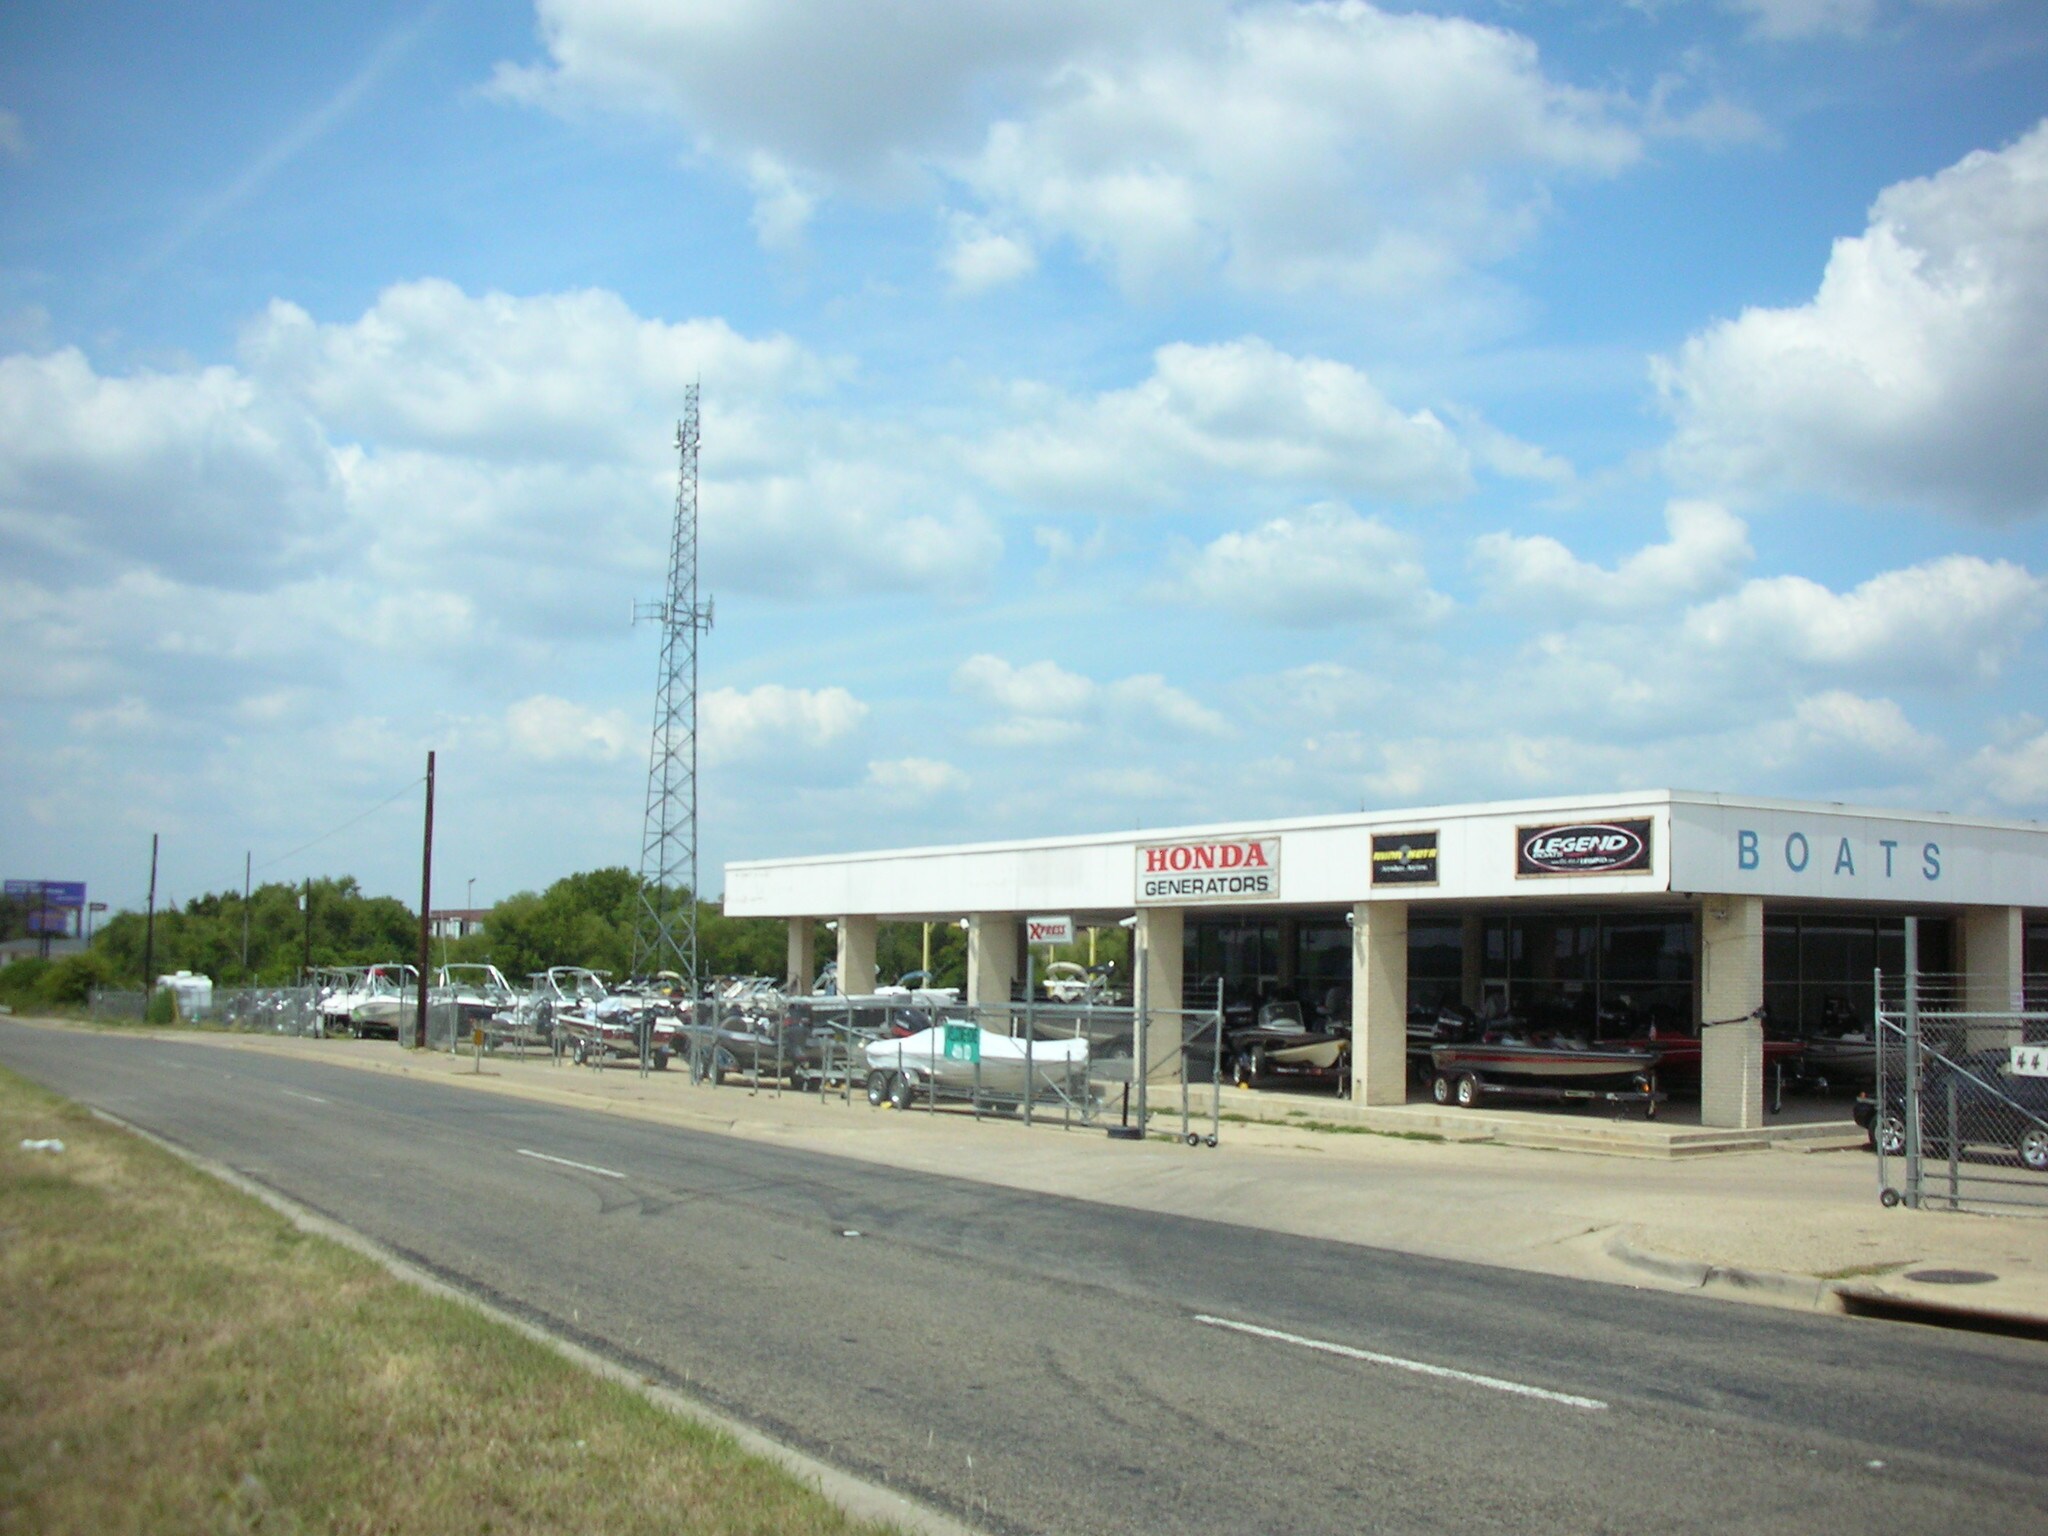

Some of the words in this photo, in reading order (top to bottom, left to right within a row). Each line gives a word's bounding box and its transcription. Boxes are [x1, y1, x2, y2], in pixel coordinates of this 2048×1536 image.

[1146, 841, 1269, 873] HONDA
[1532, 834, 1628, 854] LEGEND
[1737, 829, 1941, 882] BOATS
[1145, 875, 1269, 897] GENERATORS
